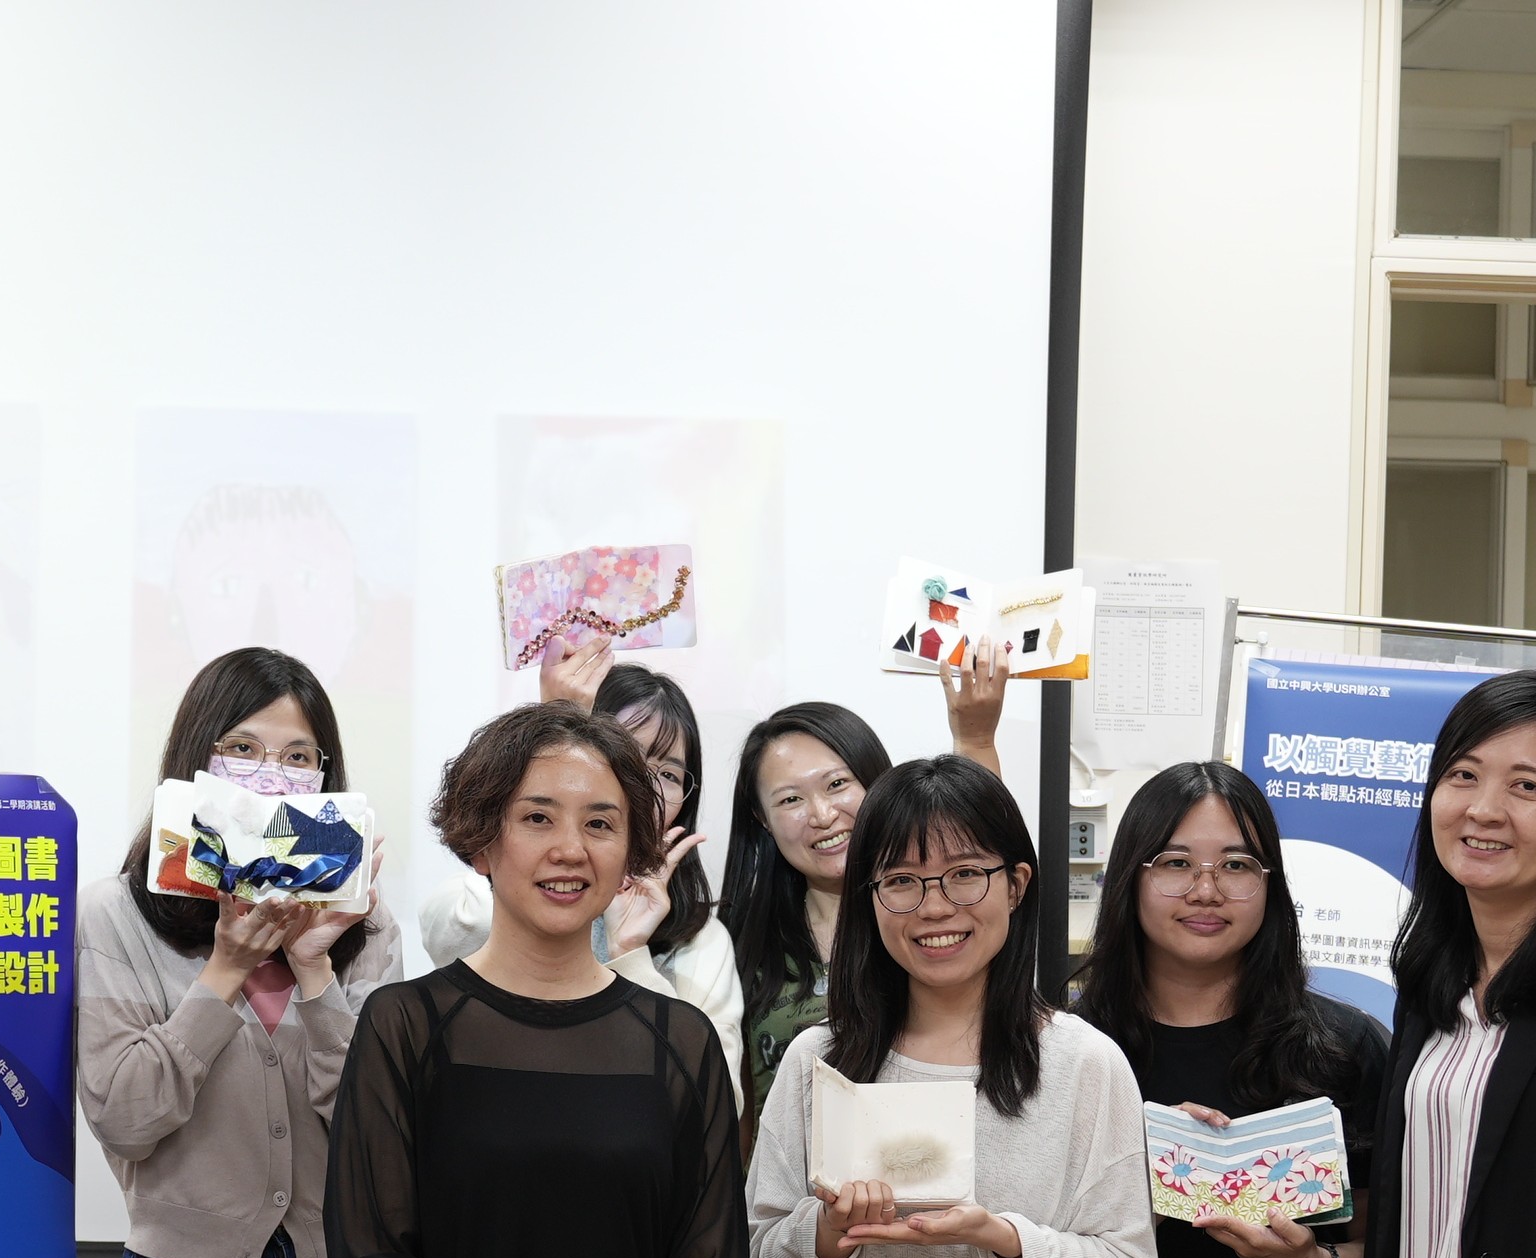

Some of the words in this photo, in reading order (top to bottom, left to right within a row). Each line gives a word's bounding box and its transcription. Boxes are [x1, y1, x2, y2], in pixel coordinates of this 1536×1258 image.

[1266, 678, 1391, 698] 國立中興大學USR辦公室
[1313, 908, 1341, 922] 老師
